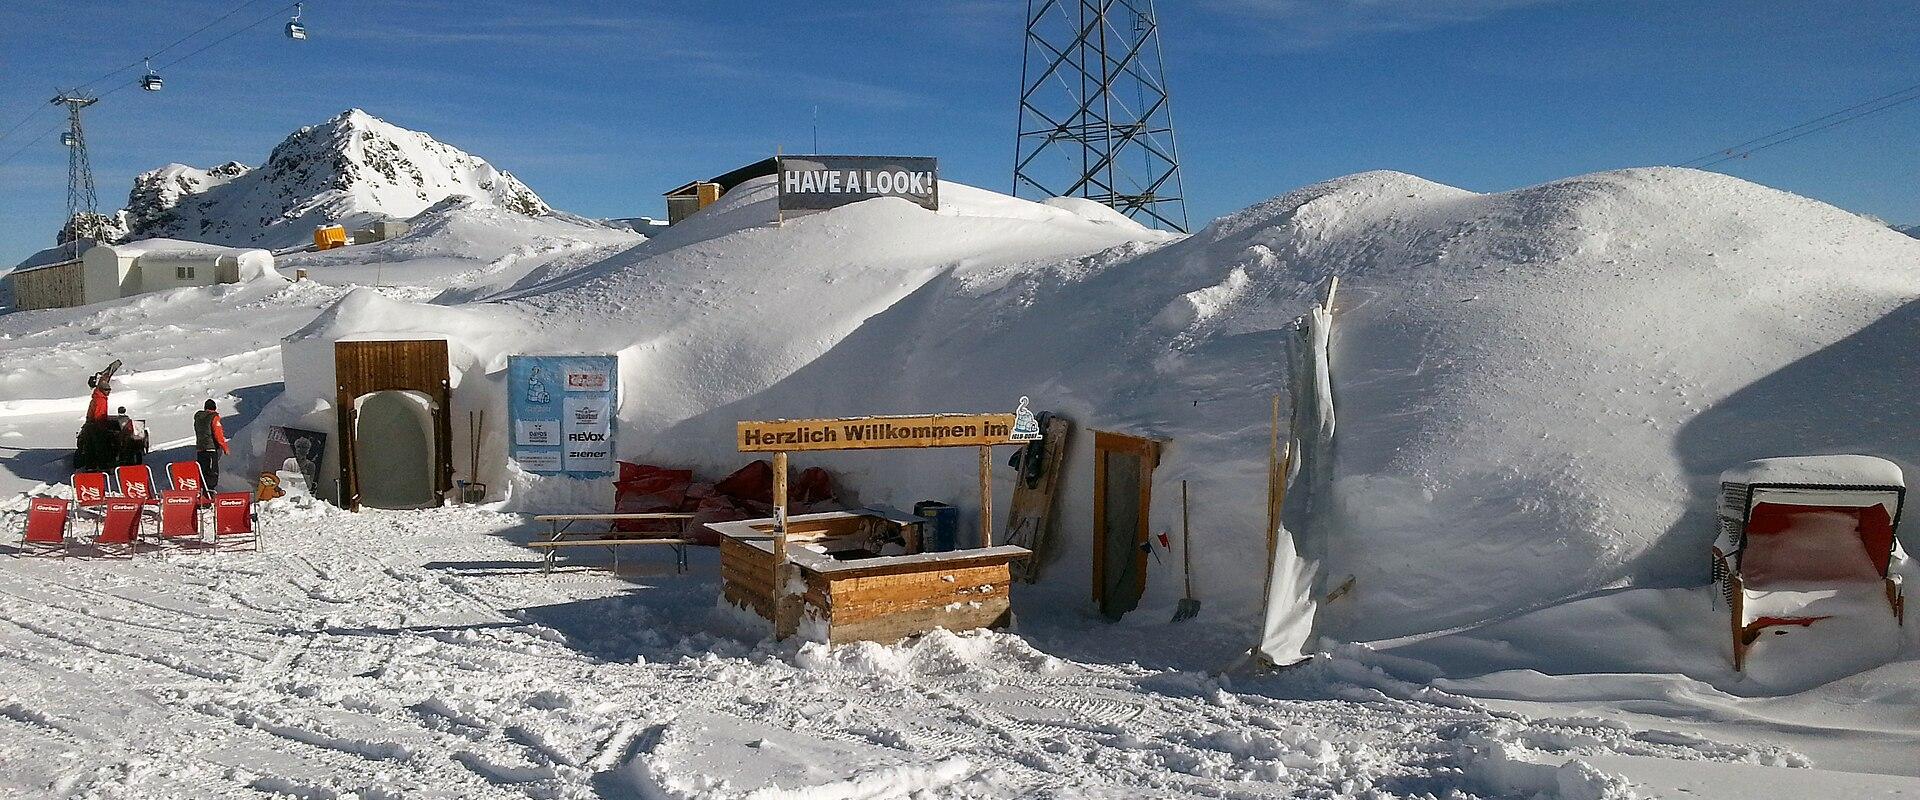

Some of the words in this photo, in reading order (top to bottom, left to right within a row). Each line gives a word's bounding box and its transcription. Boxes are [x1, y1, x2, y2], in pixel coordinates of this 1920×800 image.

[785, 170, 841, 194] HAVE
[845, 171, 861, 194] A
[865, 171, 934, 195] LOOK!
[744, 426, 837, 446] Herzlich
[843, 422, 977, 442] Willkommen
[983, 420, 1009, 437] im
